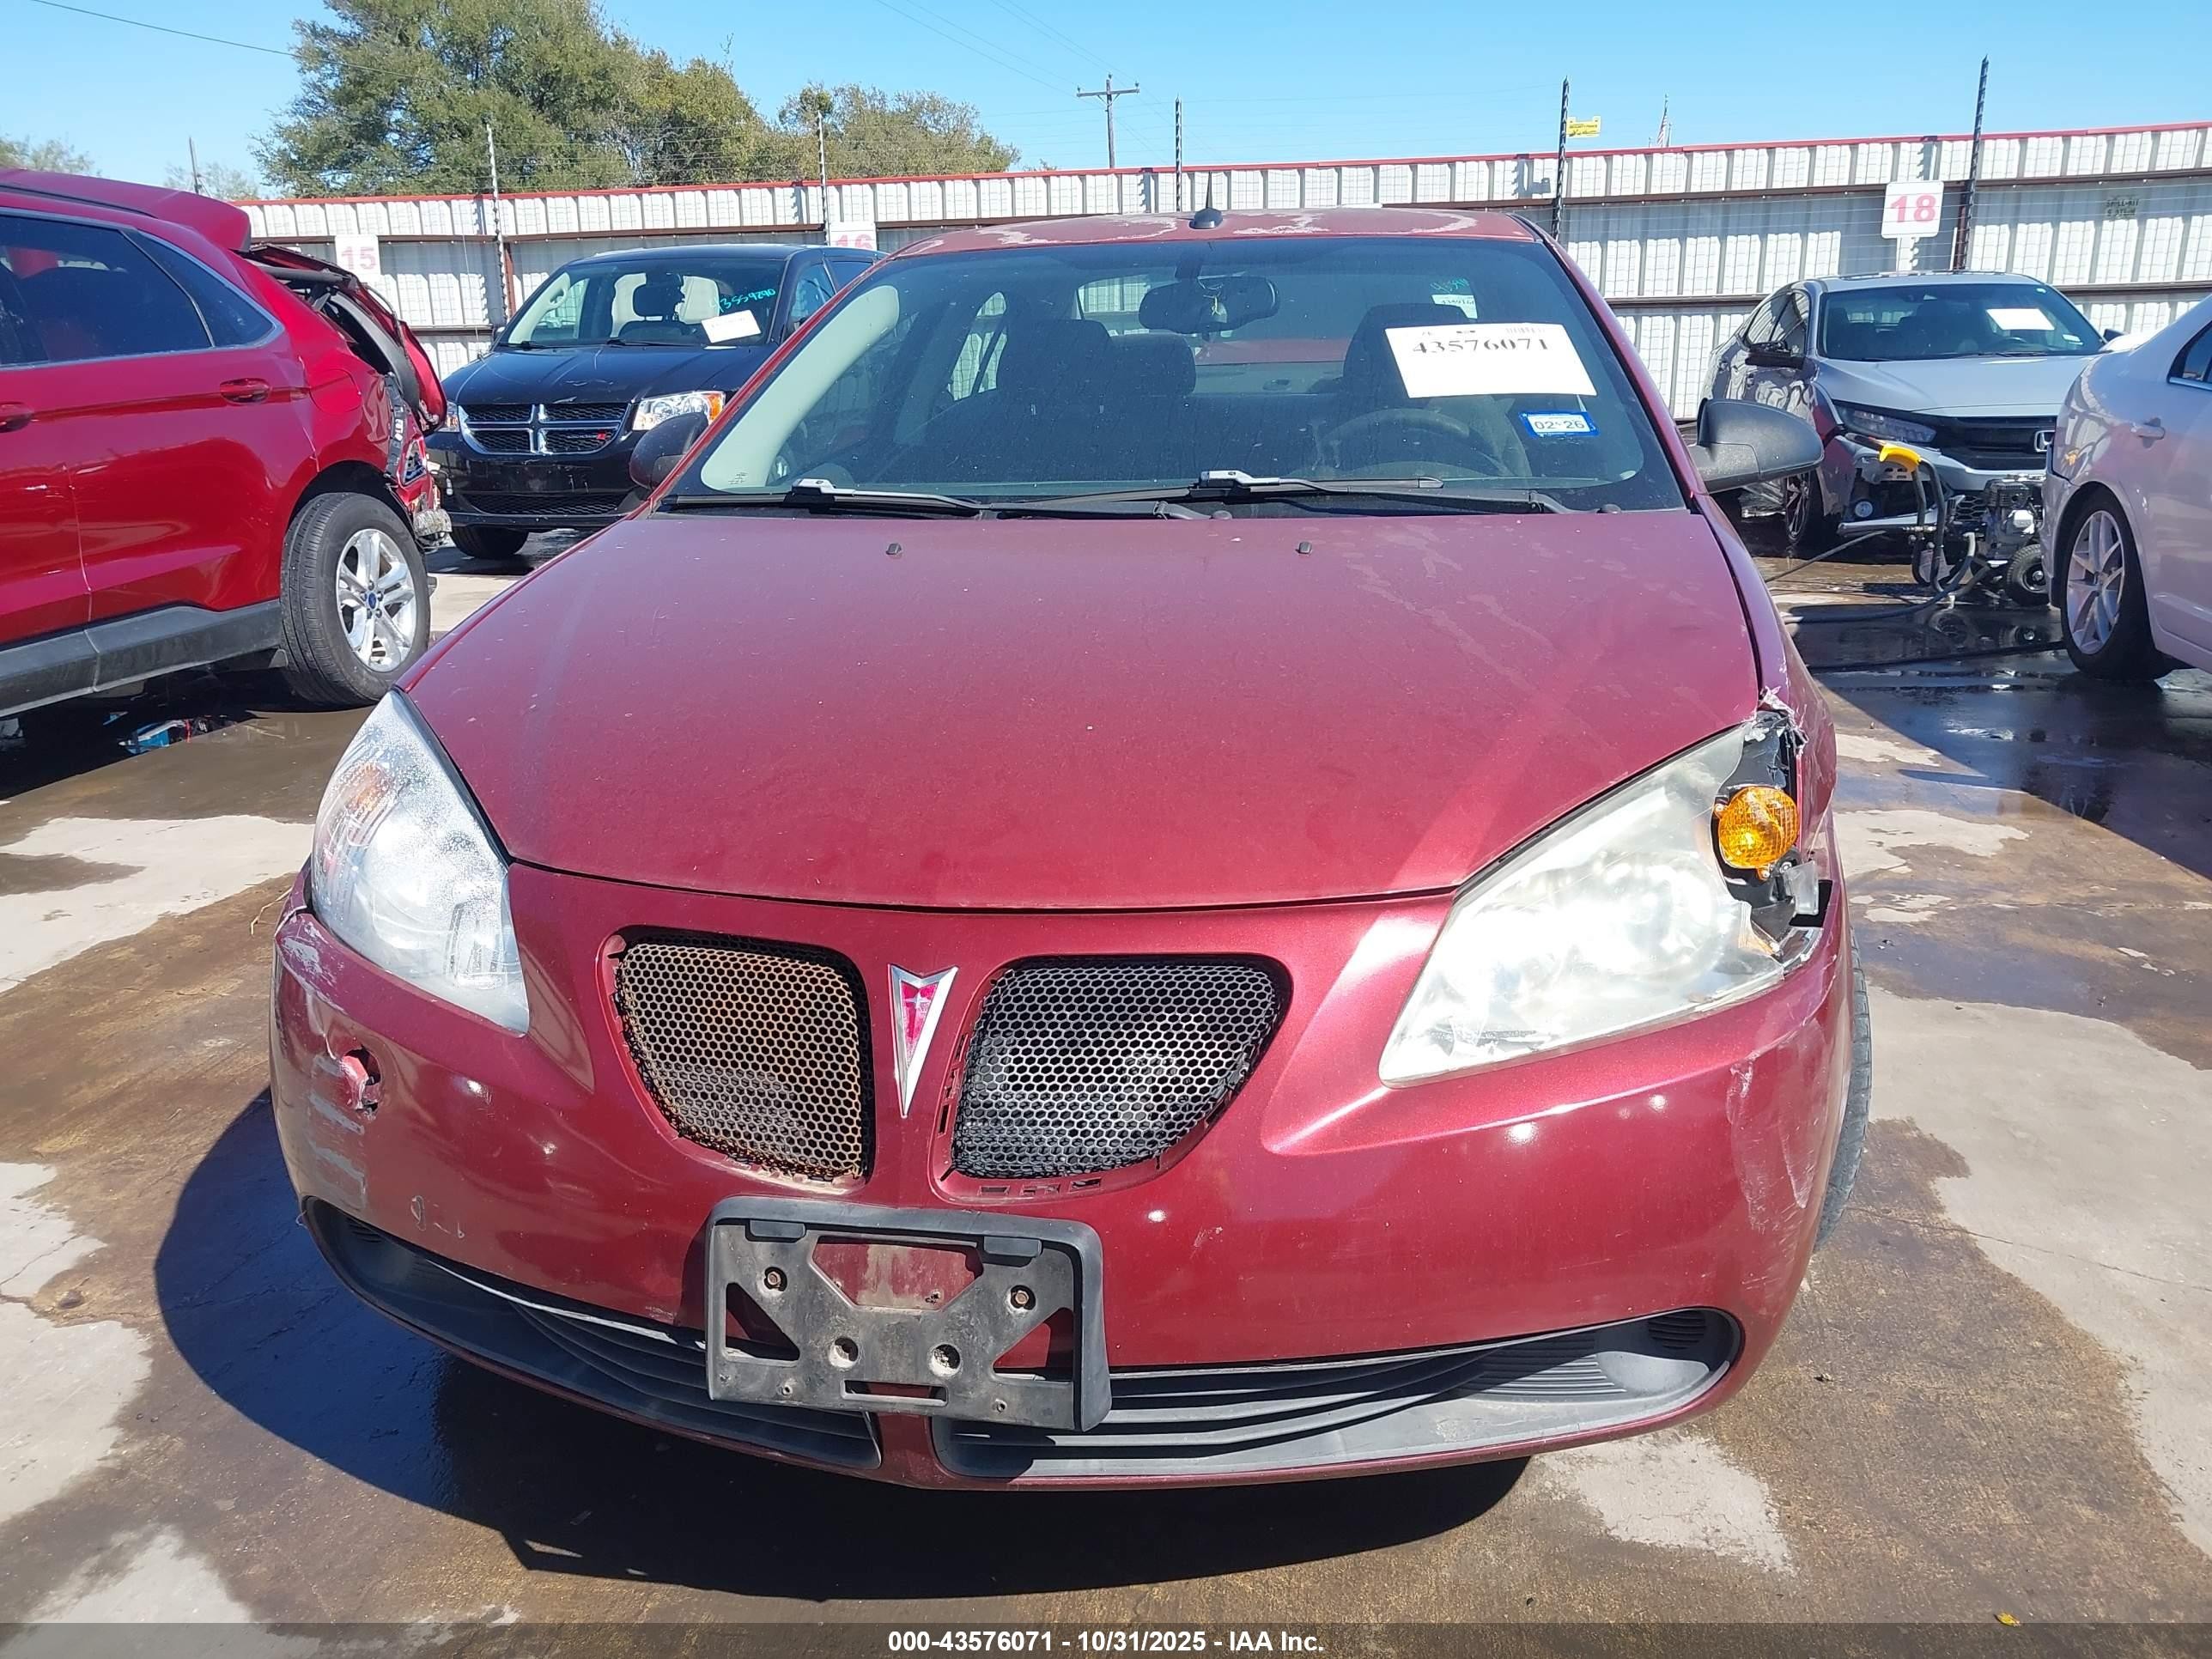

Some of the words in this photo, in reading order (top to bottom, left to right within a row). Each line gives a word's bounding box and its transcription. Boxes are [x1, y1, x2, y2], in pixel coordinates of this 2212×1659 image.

[1890, 194, 1936, 223] 18
[342, 246, 376, 270] 15
[1413, 338, 1549, 354] 43576071
[1534, 420, 1557, 430] 02
[1563, 419, 1585, 429] 26
